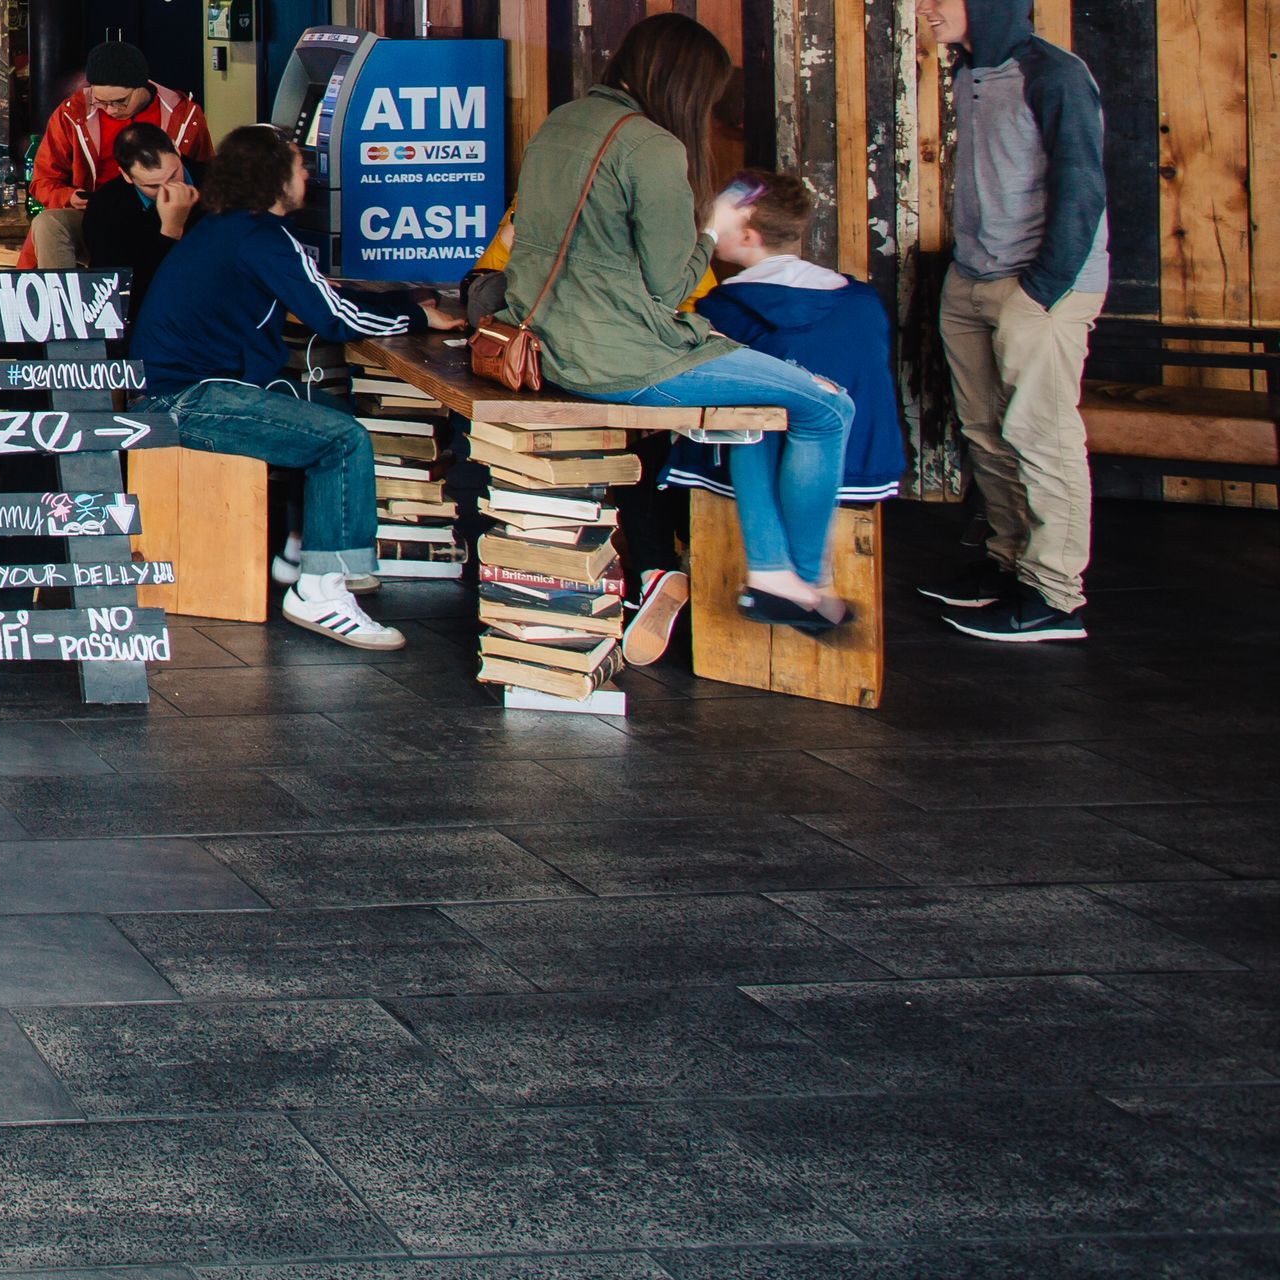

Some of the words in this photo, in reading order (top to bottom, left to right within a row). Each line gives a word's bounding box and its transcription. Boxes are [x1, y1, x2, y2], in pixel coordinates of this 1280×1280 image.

[360, 86, 486, 131] ATM
[422, 145, 462, 160] VISA
[361, 174, 382, 183] ALL
[385, 174, 423, 183] CARDS
[426, 173, 485, 182] ACCEPTED
[360, 205, 486, 241] CASH
[361, 246, 485, 261] WITHDRAWALS
[7, 360, 147, 390] #genmunch
[88, 606, 133, 632] NO
